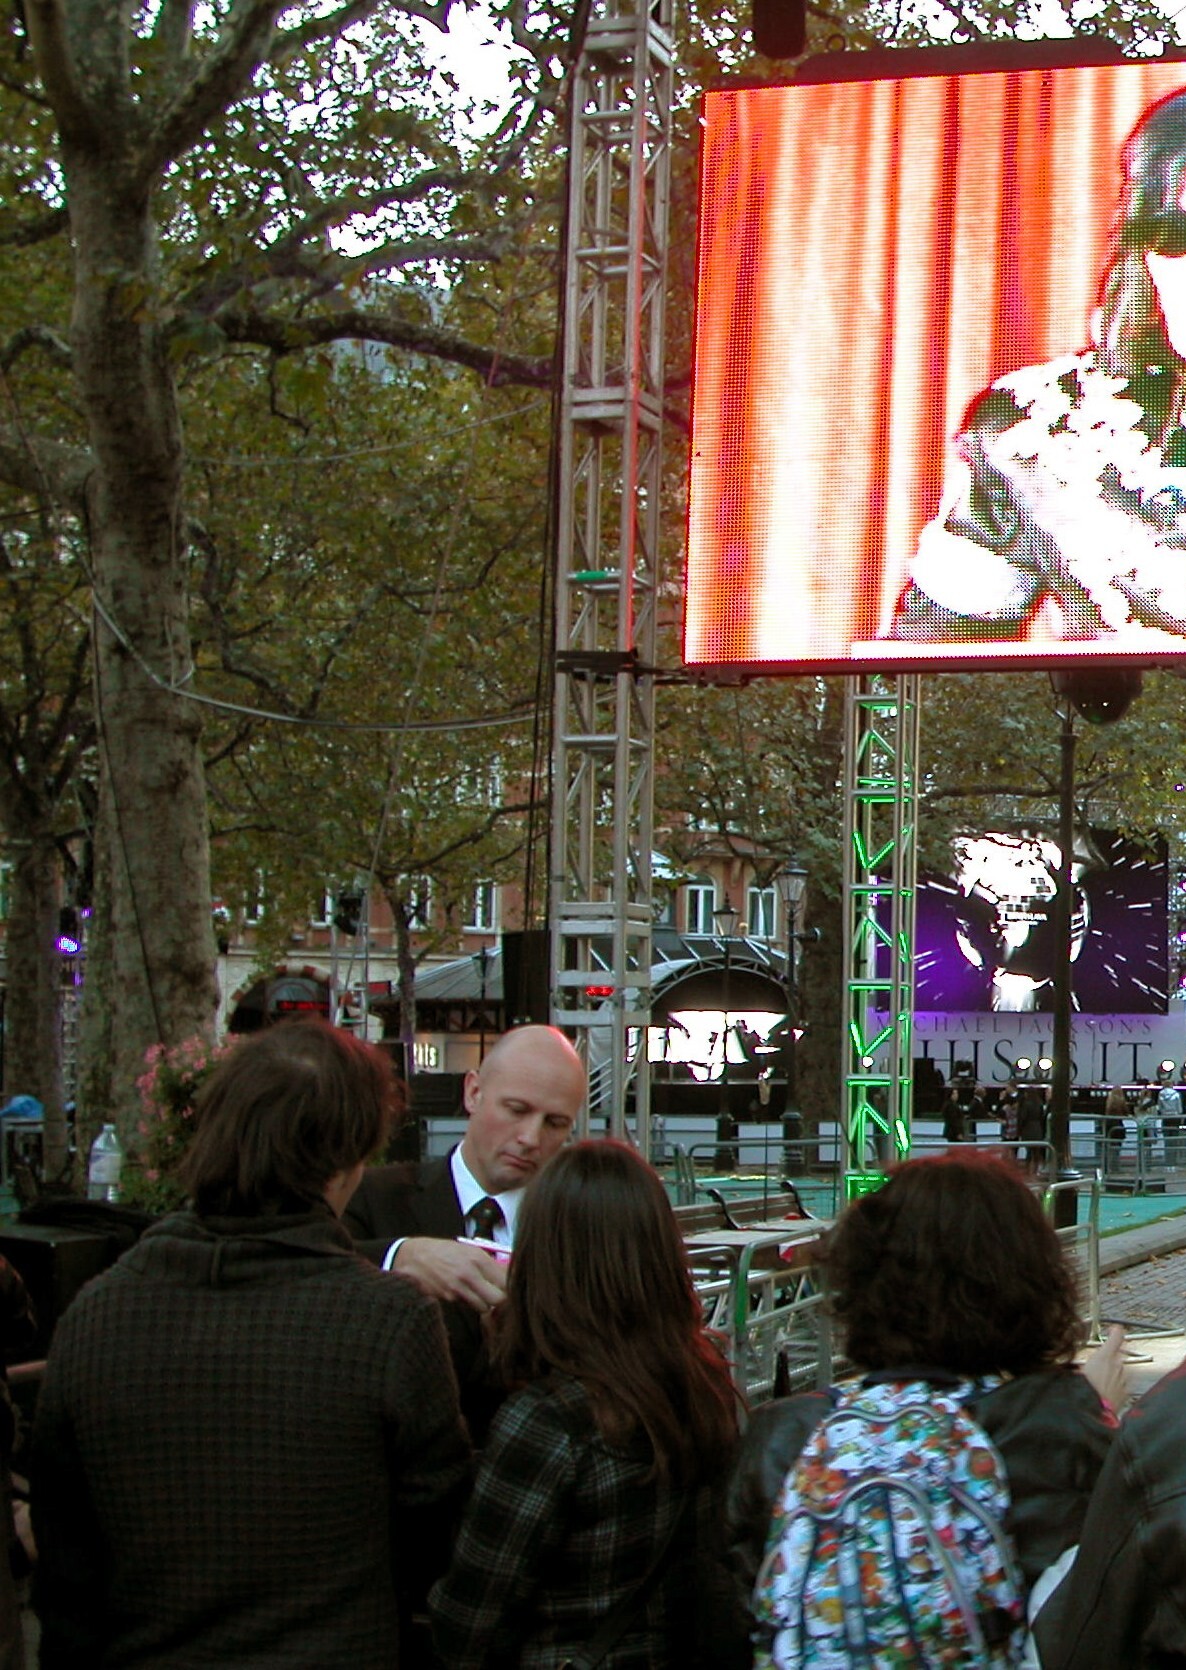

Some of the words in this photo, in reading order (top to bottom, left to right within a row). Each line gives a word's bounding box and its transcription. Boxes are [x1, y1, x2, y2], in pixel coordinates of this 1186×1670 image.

[876, 1014, 1003, 1033] MCHAEL
[884, 1038, 1014, 1083] HIS
[1097, 1040, 1153, 1084] IT
